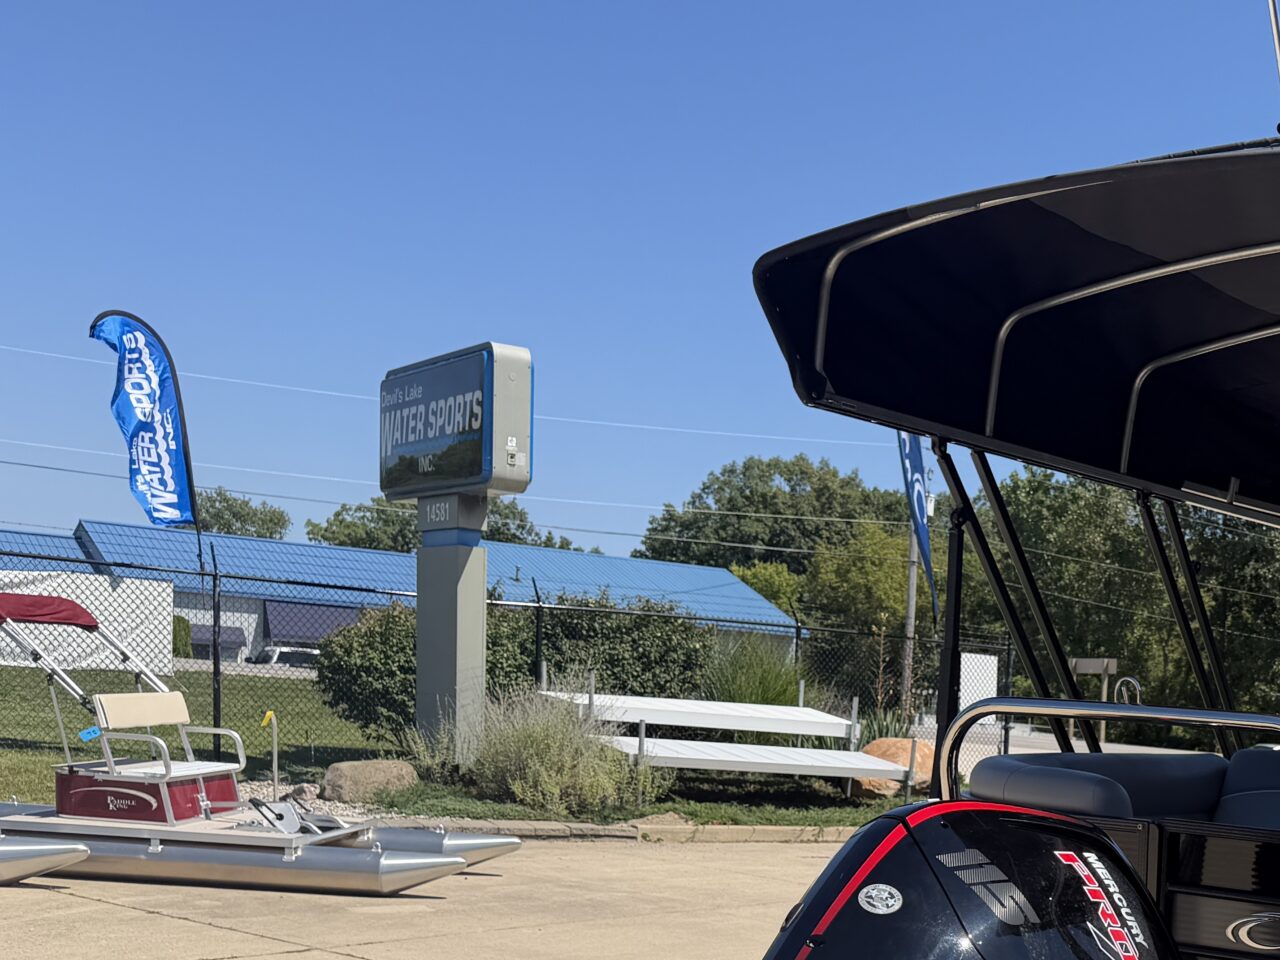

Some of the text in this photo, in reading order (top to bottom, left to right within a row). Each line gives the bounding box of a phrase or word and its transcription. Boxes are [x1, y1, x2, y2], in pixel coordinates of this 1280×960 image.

[382, 384, 423, 407] Devil's Lake
[123, 331, 181, 519] WATER SPORTS
[163, 408, 177, 450] INC.
[381, 390, 483, 457] WATER SPORTS
[131, 437, 139, 469] Lake
[418, 454, 436, 473] INC.
[426, 502, 450, 522] 14581
[1082, 852, 1149, 949] MERCURY
